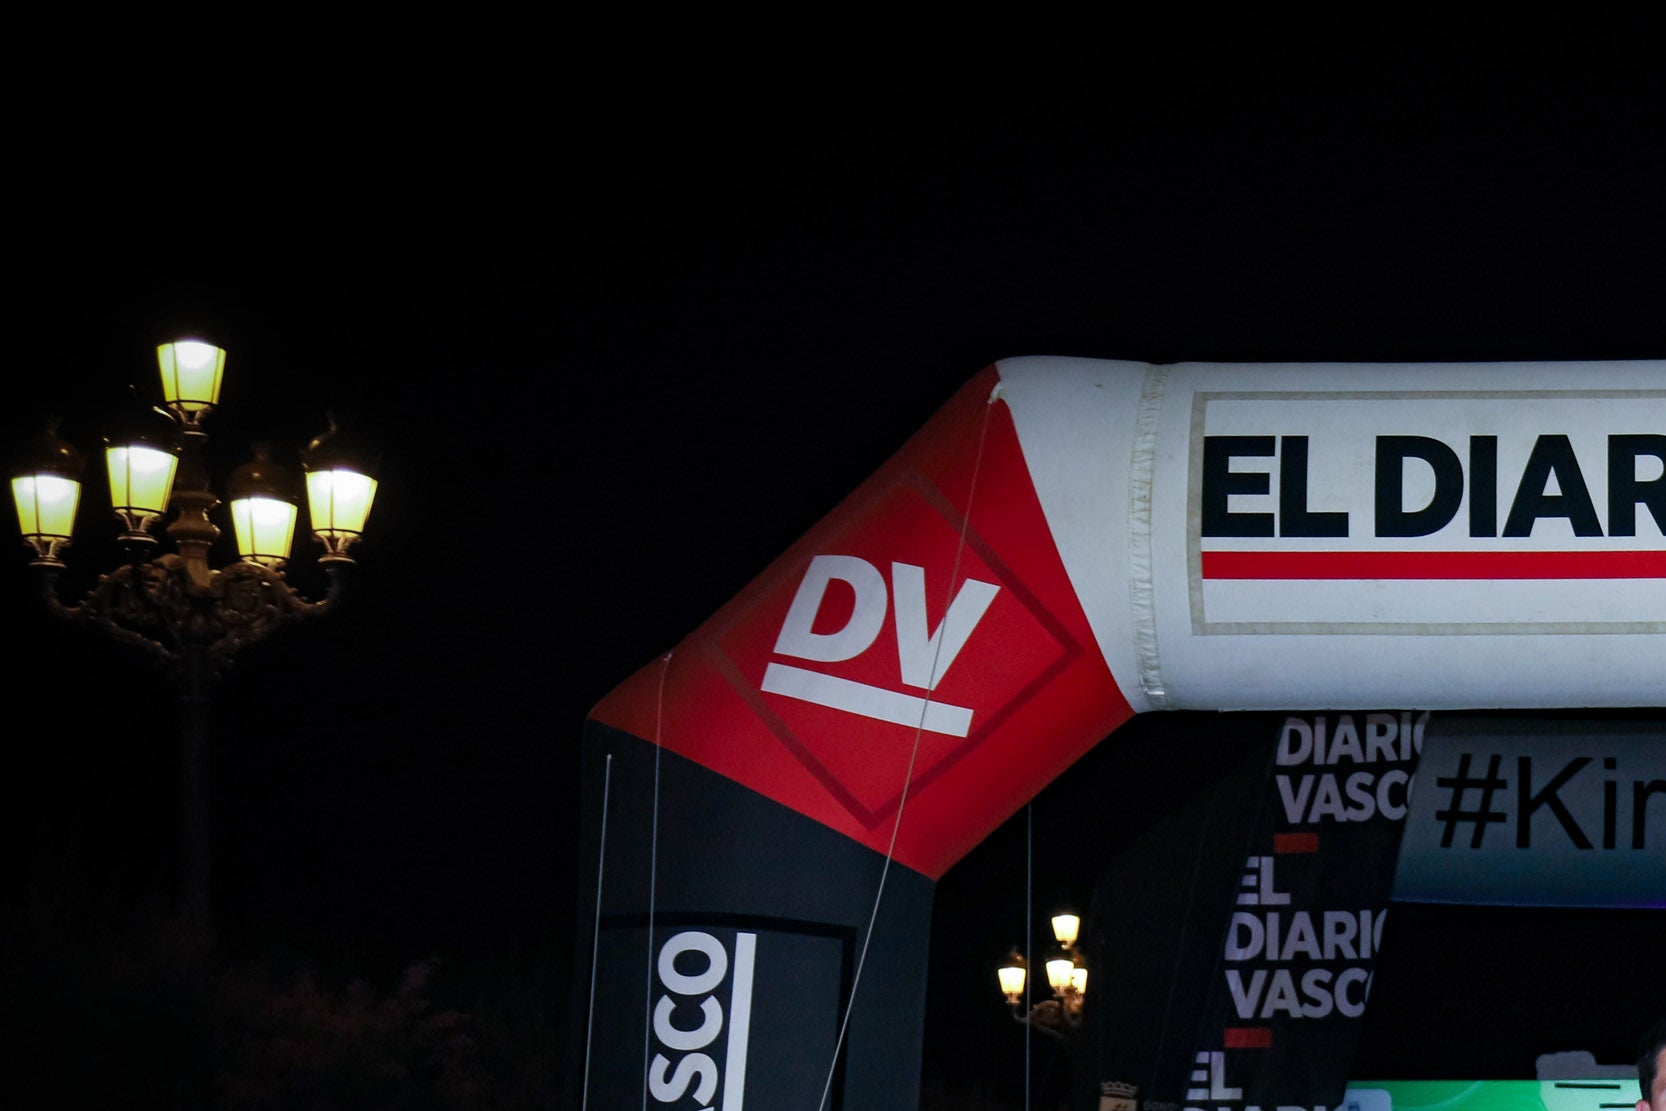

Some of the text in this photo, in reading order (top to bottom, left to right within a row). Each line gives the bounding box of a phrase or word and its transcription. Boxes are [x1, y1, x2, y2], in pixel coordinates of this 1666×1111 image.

[1201, 435, 1349, 538] EL
[773, 553, 1001, 691] DV
[1275, 770, 1416, 824] VASC
[1224, 967, 1374, 1019] VASC
